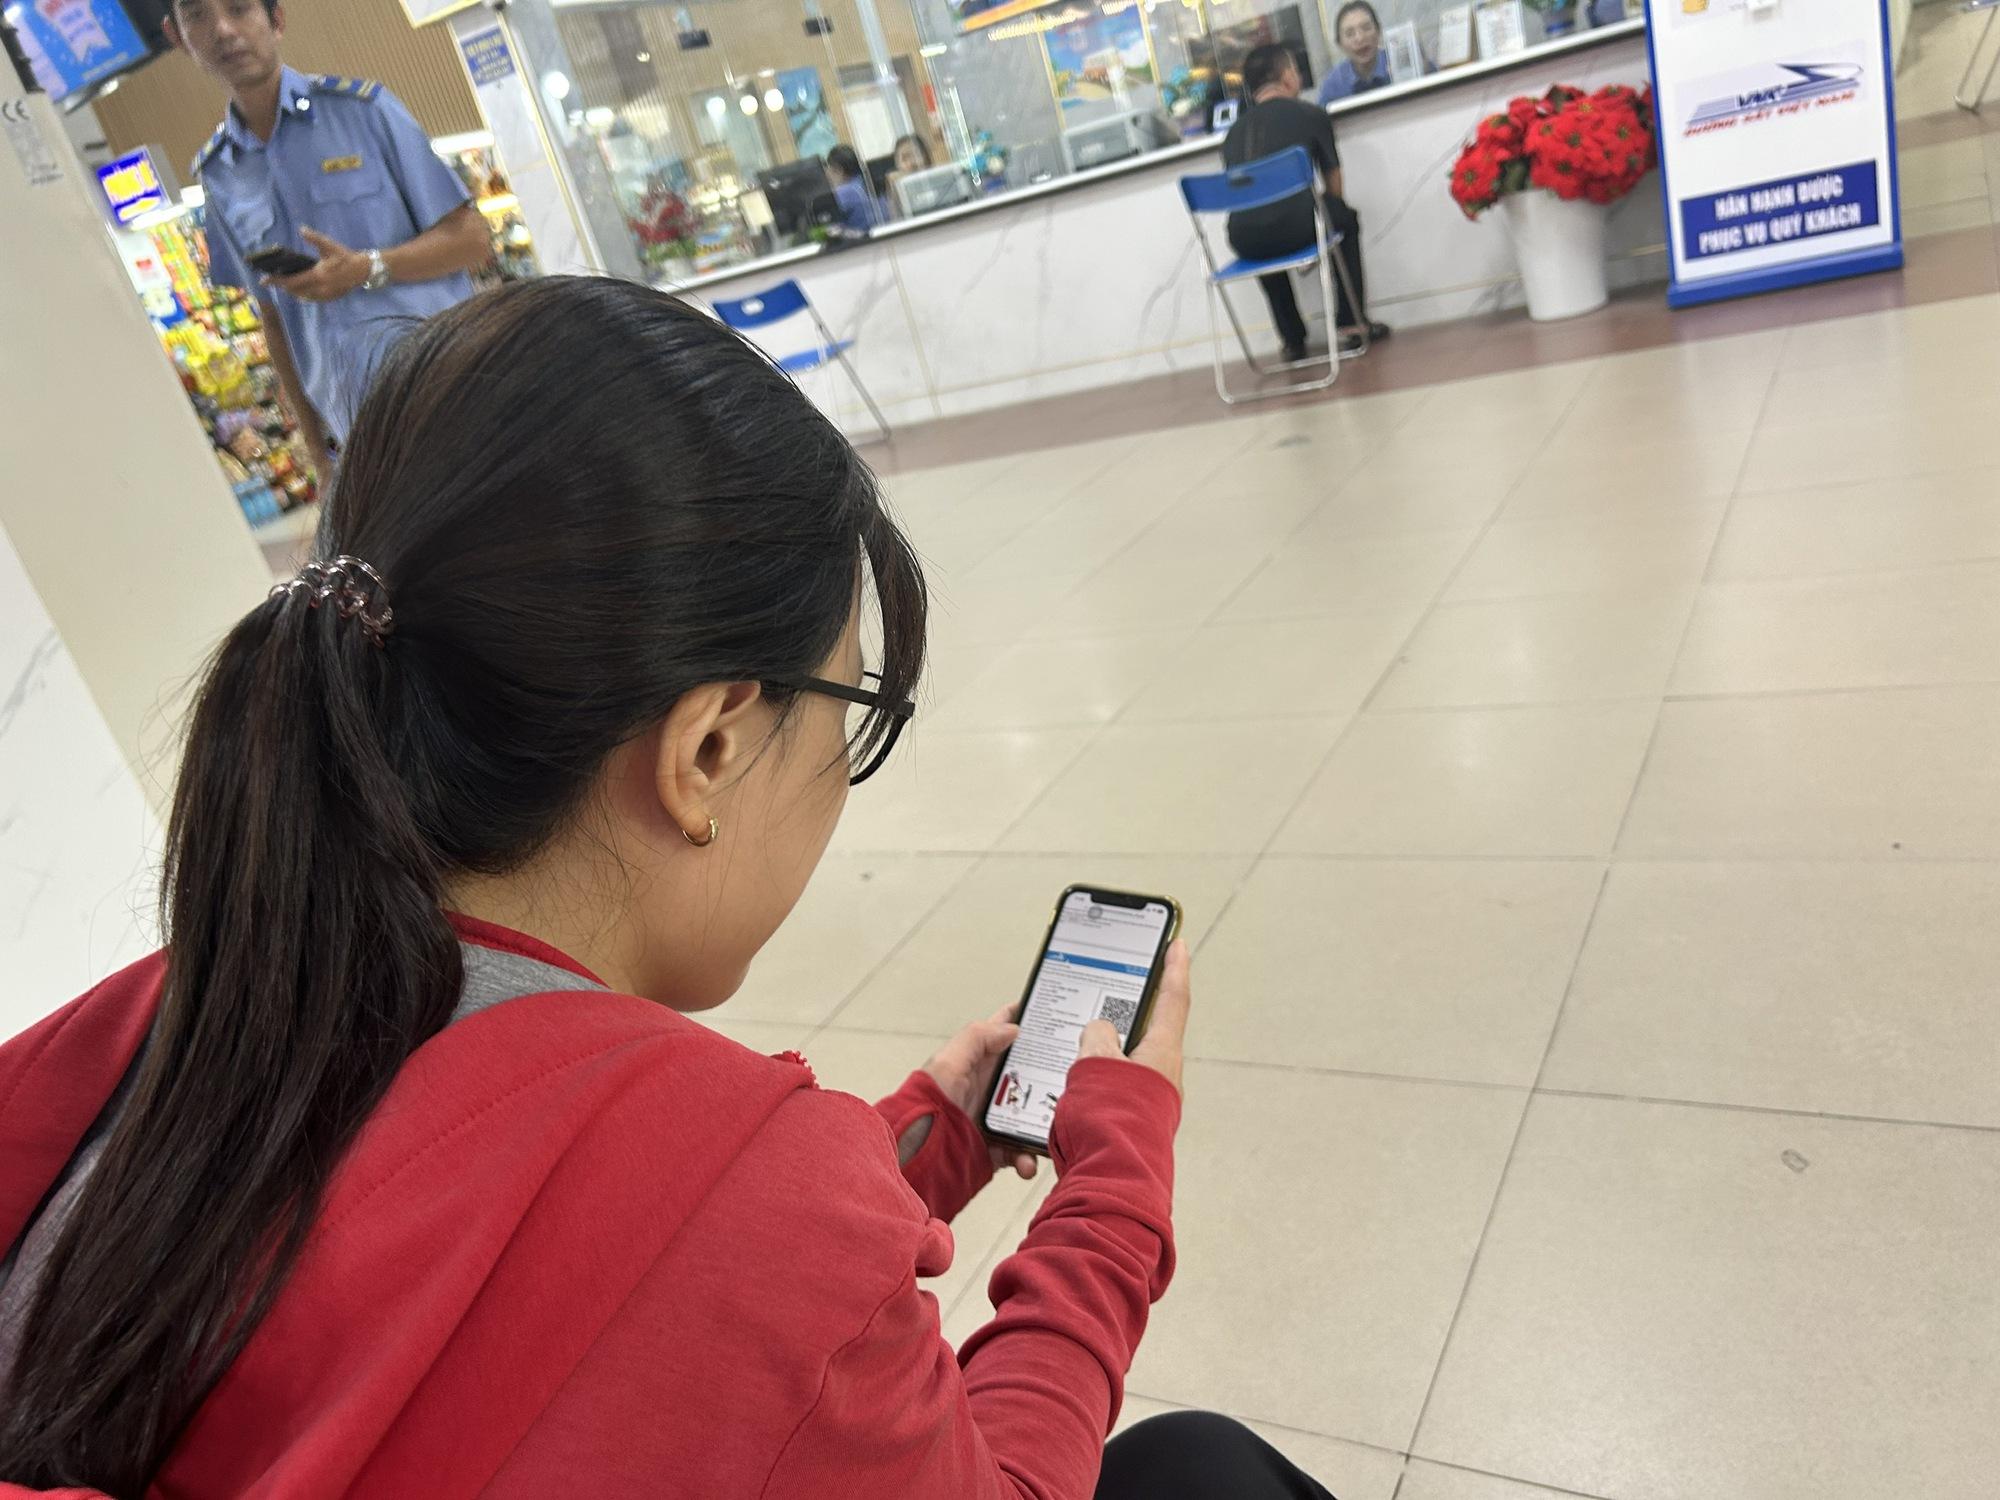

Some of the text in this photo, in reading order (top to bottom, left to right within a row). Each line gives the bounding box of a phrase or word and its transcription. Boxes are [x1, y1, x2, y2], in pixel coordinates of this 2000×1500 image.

[1750, 184, 1795, 214] HẠNH
[1797, 174, 1844, 204] ĐƯỢC
[1699, 202, 1861, 254] PHỤC VỤ QUÝ KHÁCH
